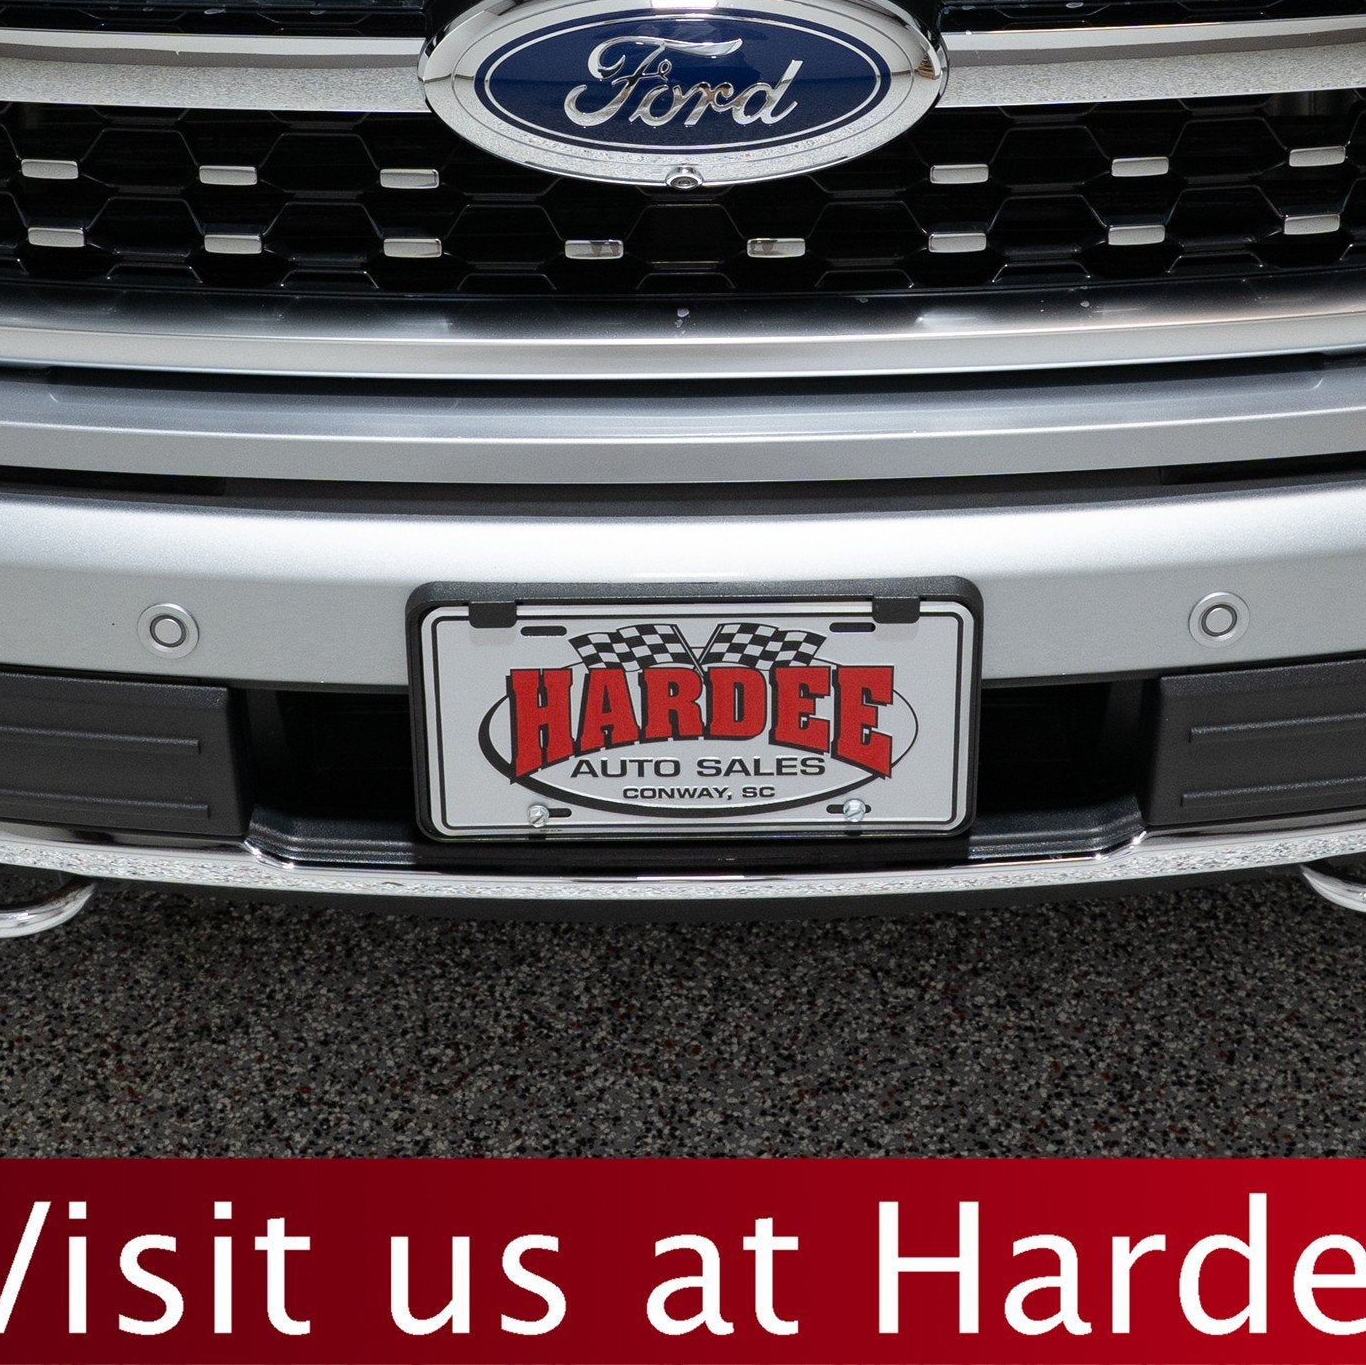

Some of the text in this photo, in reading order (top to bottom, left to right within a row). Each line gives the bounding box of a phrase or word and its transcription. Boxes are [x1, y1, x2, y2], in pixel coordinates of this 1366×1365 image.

[562, 35, 804, 128] Ford
[508, 666, 895, 781] HARDEE
[570, 757, 826, 778] AUTO SALES
[622, 786, 776, 802] CONWAY, SC
